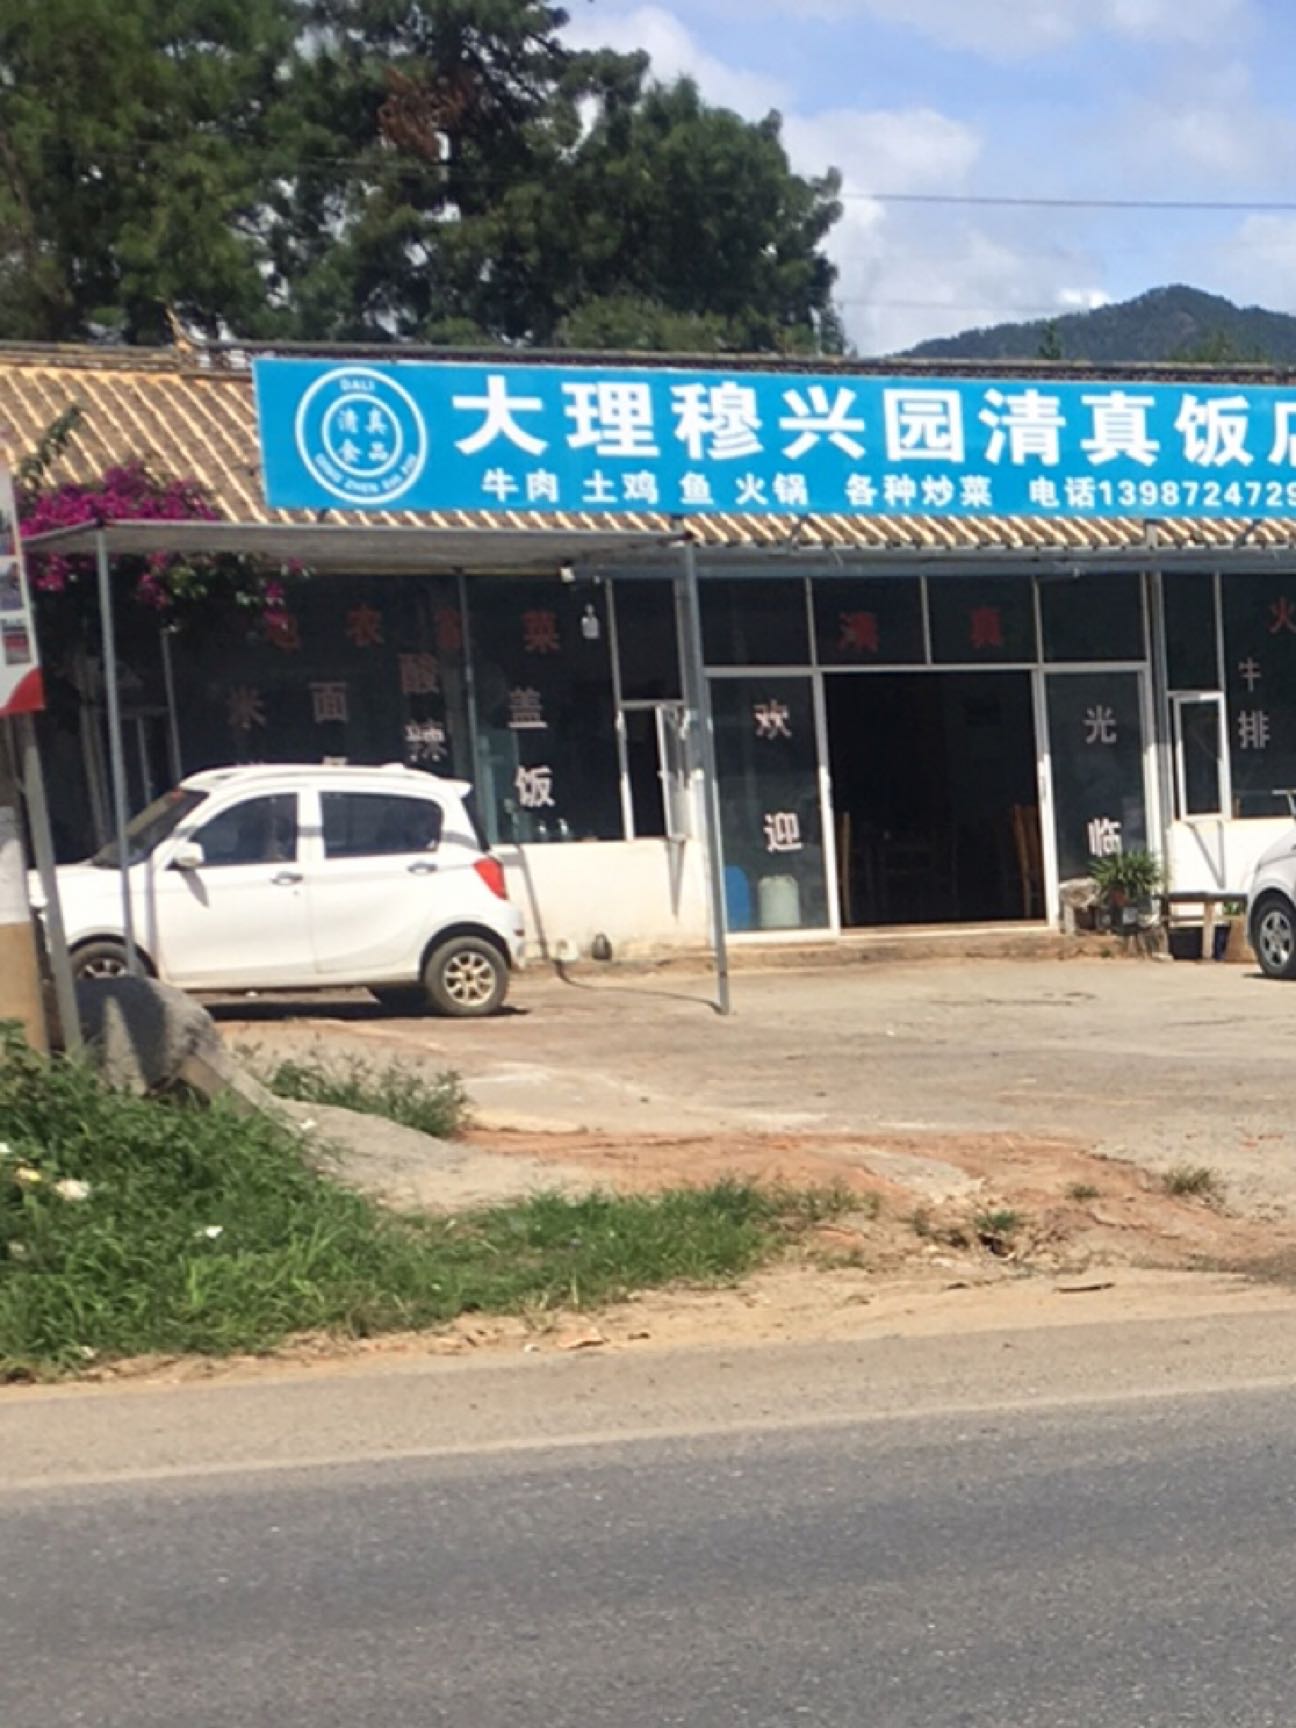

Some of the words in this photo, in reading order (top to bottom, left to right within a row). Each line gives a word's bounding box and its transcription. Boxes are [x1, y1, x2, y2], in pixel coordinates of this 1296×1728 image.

[481, 470, 558, 502] 牛肉
[582, 471, 658, 503] 土鸡
[679, 473, 714, 504] 鱼
[734, 474, 809, 506] 火锅
[844, 474, 994, 508] 各种炒菜
[1238, 656, 1270, 750] 牛排
[754, 699, 804, 854] 欢迎
[1083, 704, 1125, 857] 光临
